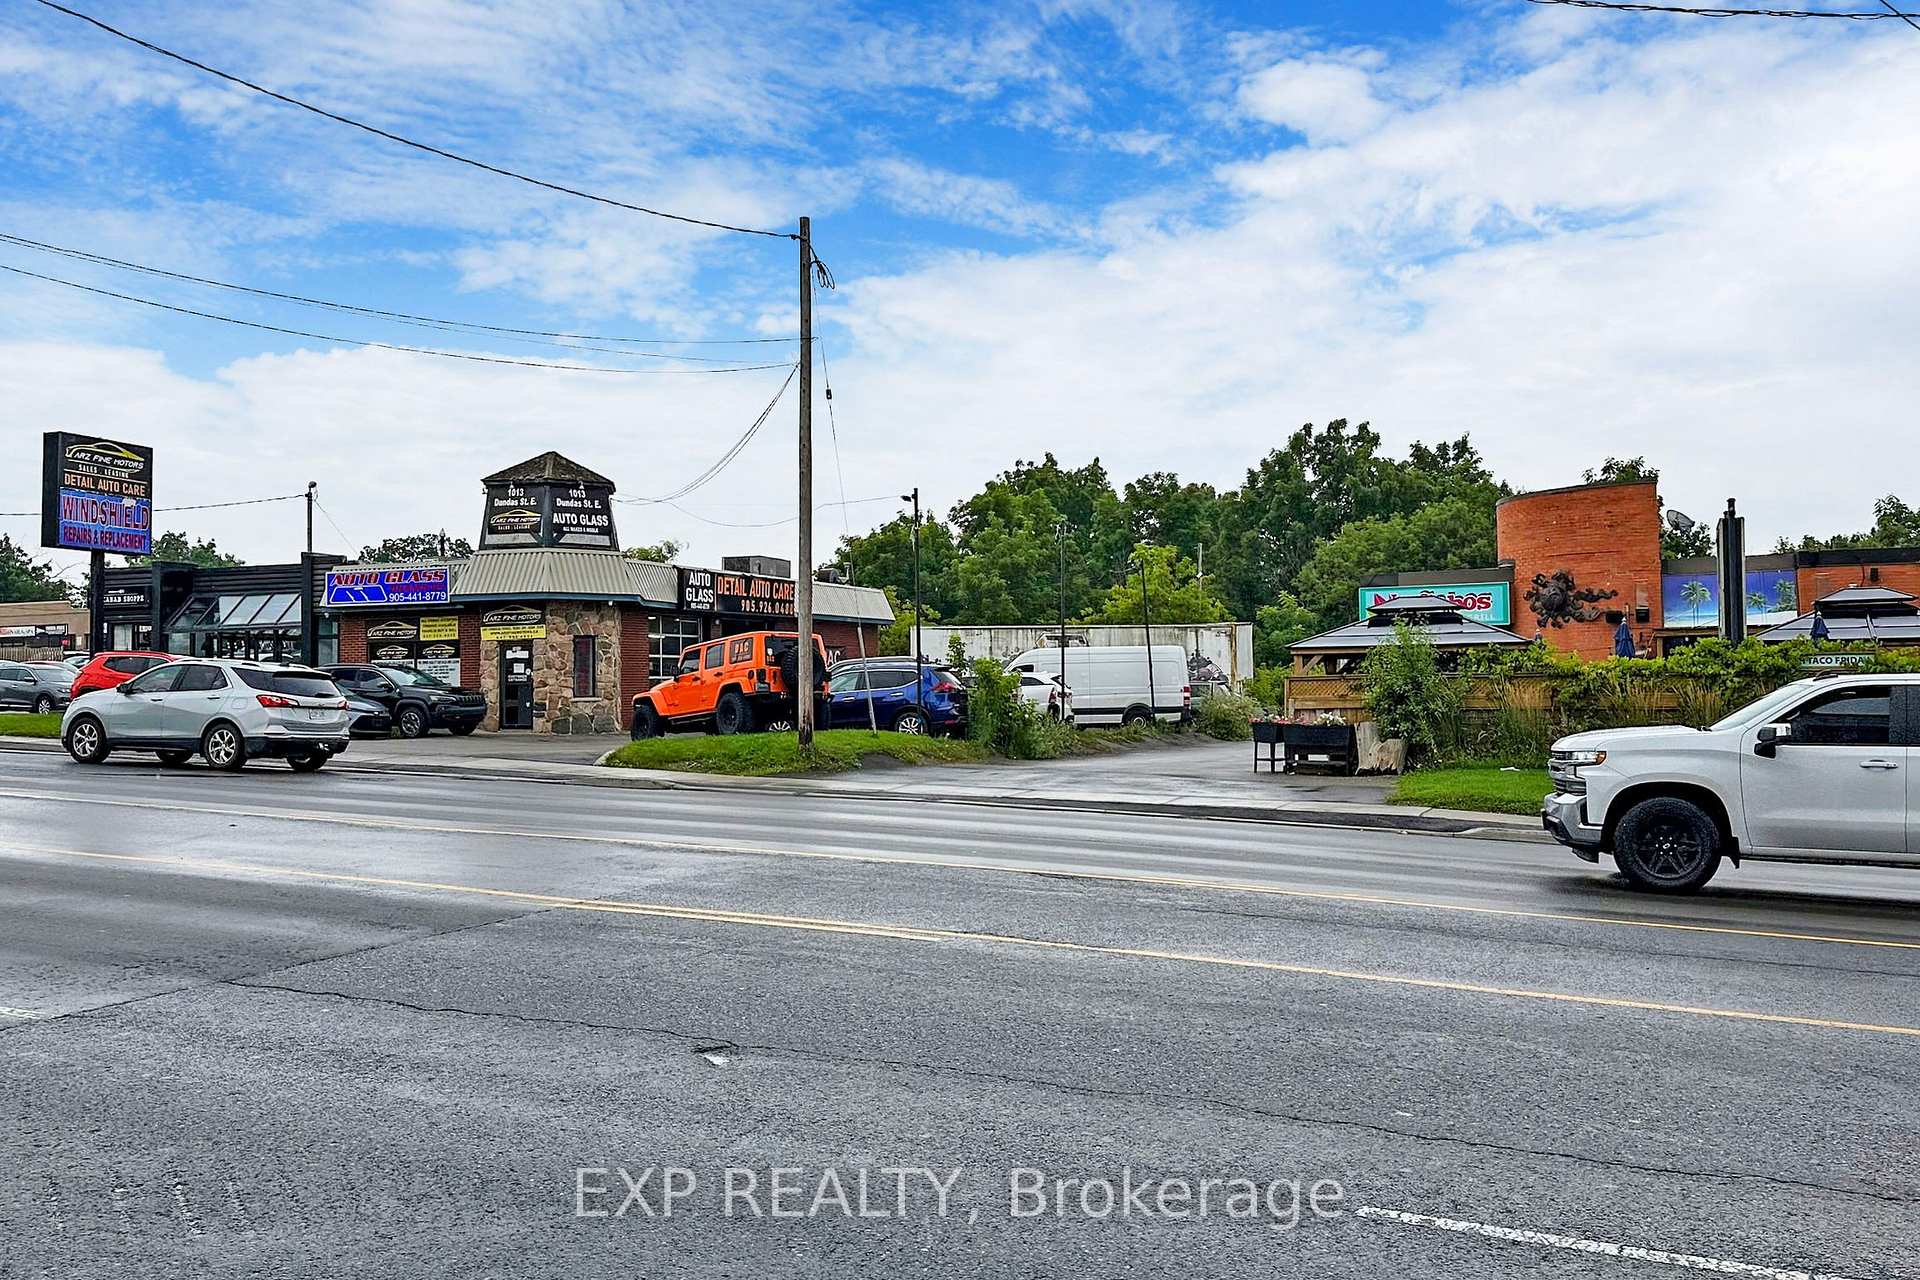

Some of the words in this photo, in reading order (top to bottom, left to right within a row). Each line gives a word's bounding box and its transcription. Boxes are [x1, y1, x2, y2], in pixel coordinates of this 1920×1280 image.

[93, 454, 113, 464] FINE
[114, 459, 144, 469] MOTORS
[78, 464, 98, 473] SALES
[104, 468, 129, 478] LEASING
[64, 473, 96, 489] DETAIL
[97, 479, 120, 492] AUTO
[122, 483, 146, 496] CARE
[507, 488, 524, 497] 1013
[568, 489, 586, 498] 1013
[494, 498, 519, 507] Dundas
[556, 498, 582, 507] Dundas
[62, 495, 150, 531] WINDSHIELD
[552, 513, 579, 525] AUTO
[580, 515, 609, 526] GLASS
[63, 526, 92, 543] REPAIRS
[100, 530, 146, 550] REPLACEMENT
[330, 571, 380, 586] AUTO
[384, 570, 446, 584] GLASS
[688, 571, 711, 587] AUTO
[717, 575, 747, 597] DETAIL
[749, 579, 771, 599] AUTO
[772, 582, 795, 600] CARE
[389, 591, 447, 602] 905-441-8779
[685, 587, 714, 603] GLASS
[1808, 656, 1833, 664] TACO
[1835, 656, 1869, 665] FRIDA
